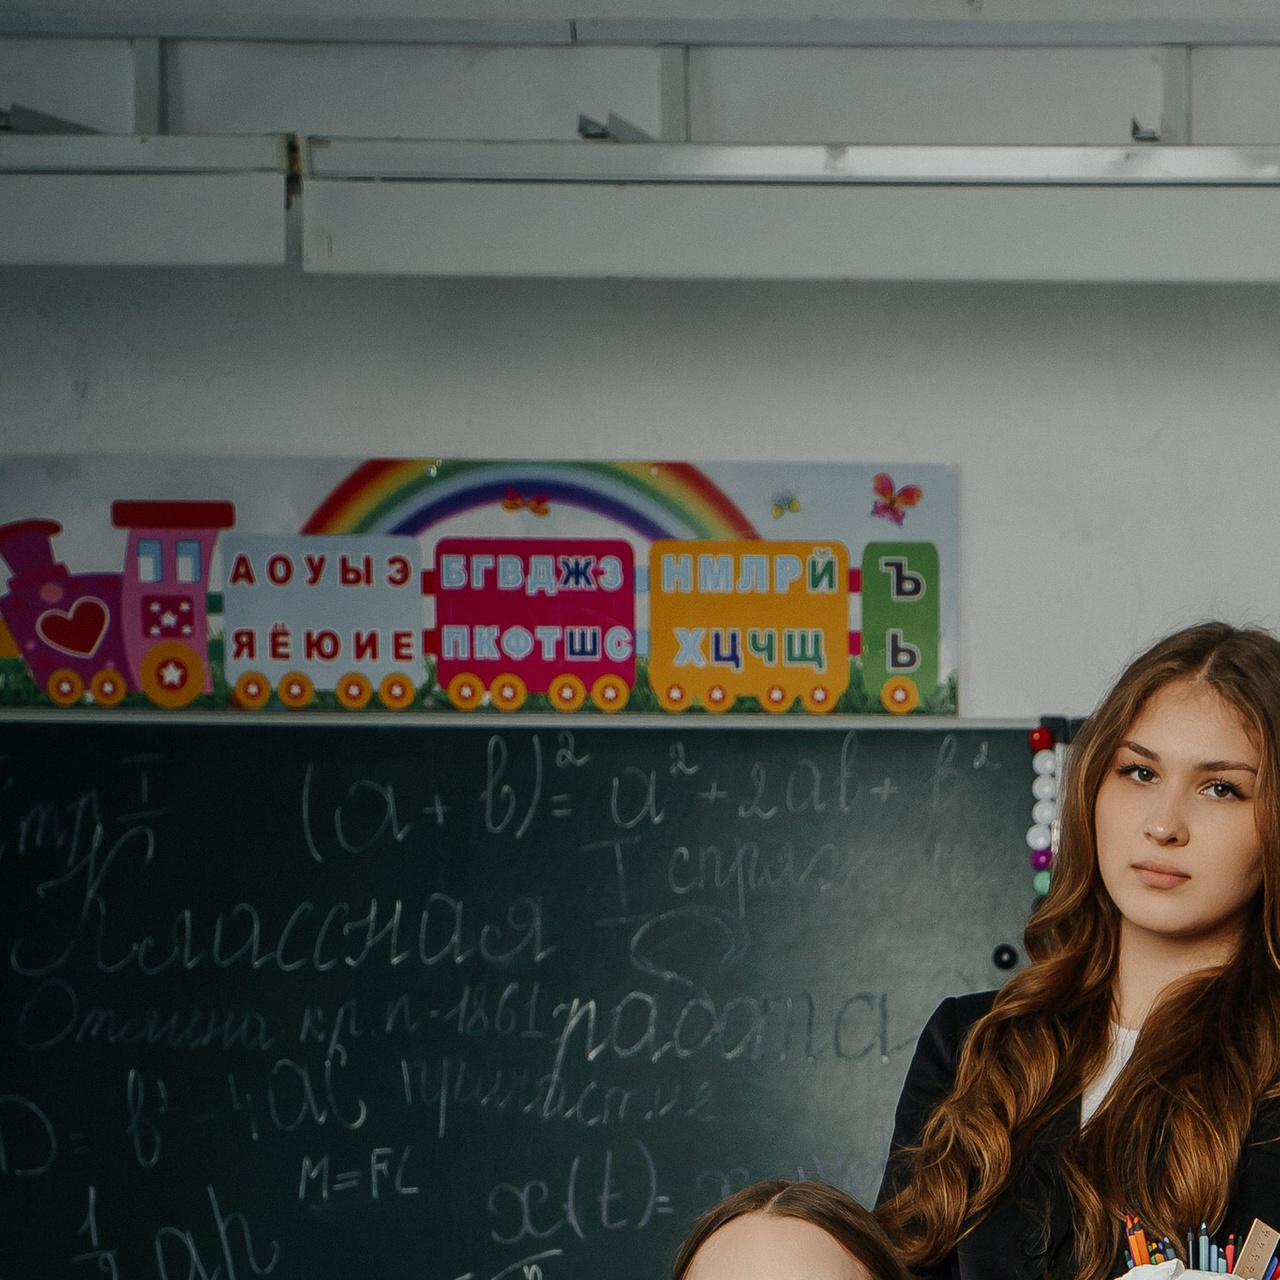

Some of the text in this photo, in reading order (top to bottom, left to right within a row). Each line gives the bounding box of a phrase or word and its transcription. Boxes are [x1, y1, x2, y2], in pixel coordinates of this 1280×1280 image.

[880, 556, 926, 601] Ъ
[886, 628, 921, 673] Ь
[10, 824, 558, 975] Классная
